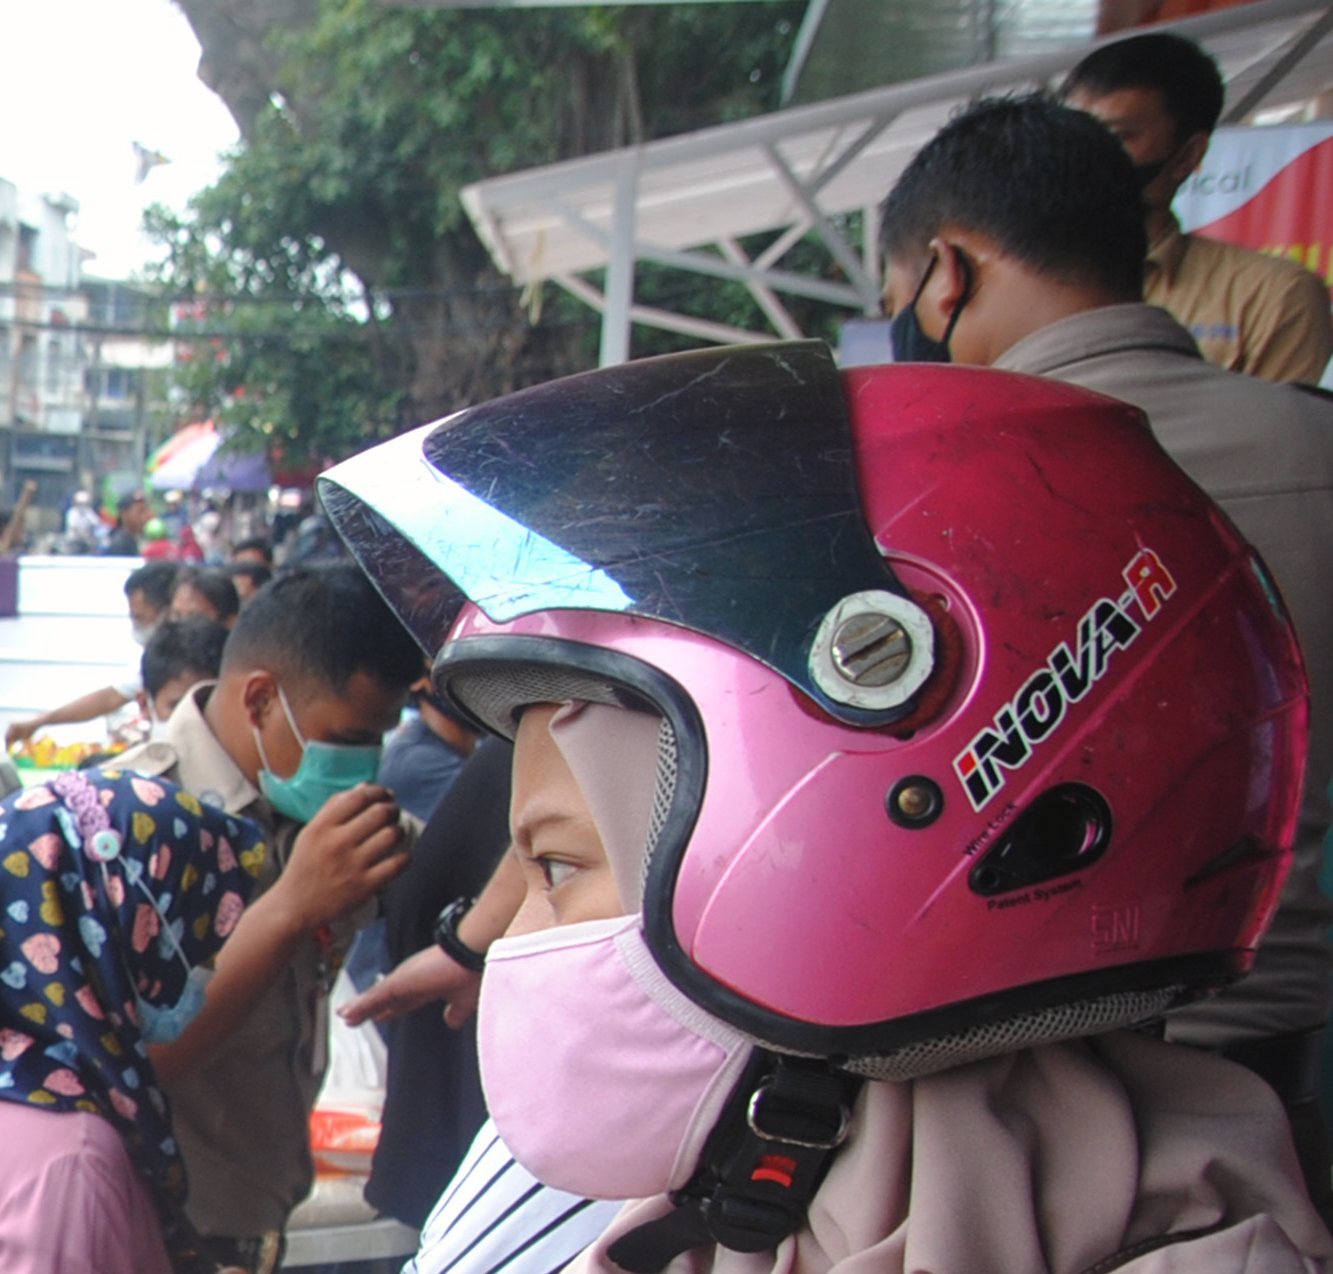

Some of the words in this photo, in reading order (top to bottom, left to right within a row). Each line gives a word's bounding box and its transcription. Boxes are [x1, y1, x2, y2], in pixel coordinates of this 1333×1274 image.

[1186, 164, 1252, 196] ical
[987, 892, 1031, 911] Patent
[1034, 879, 1083, 901] System
